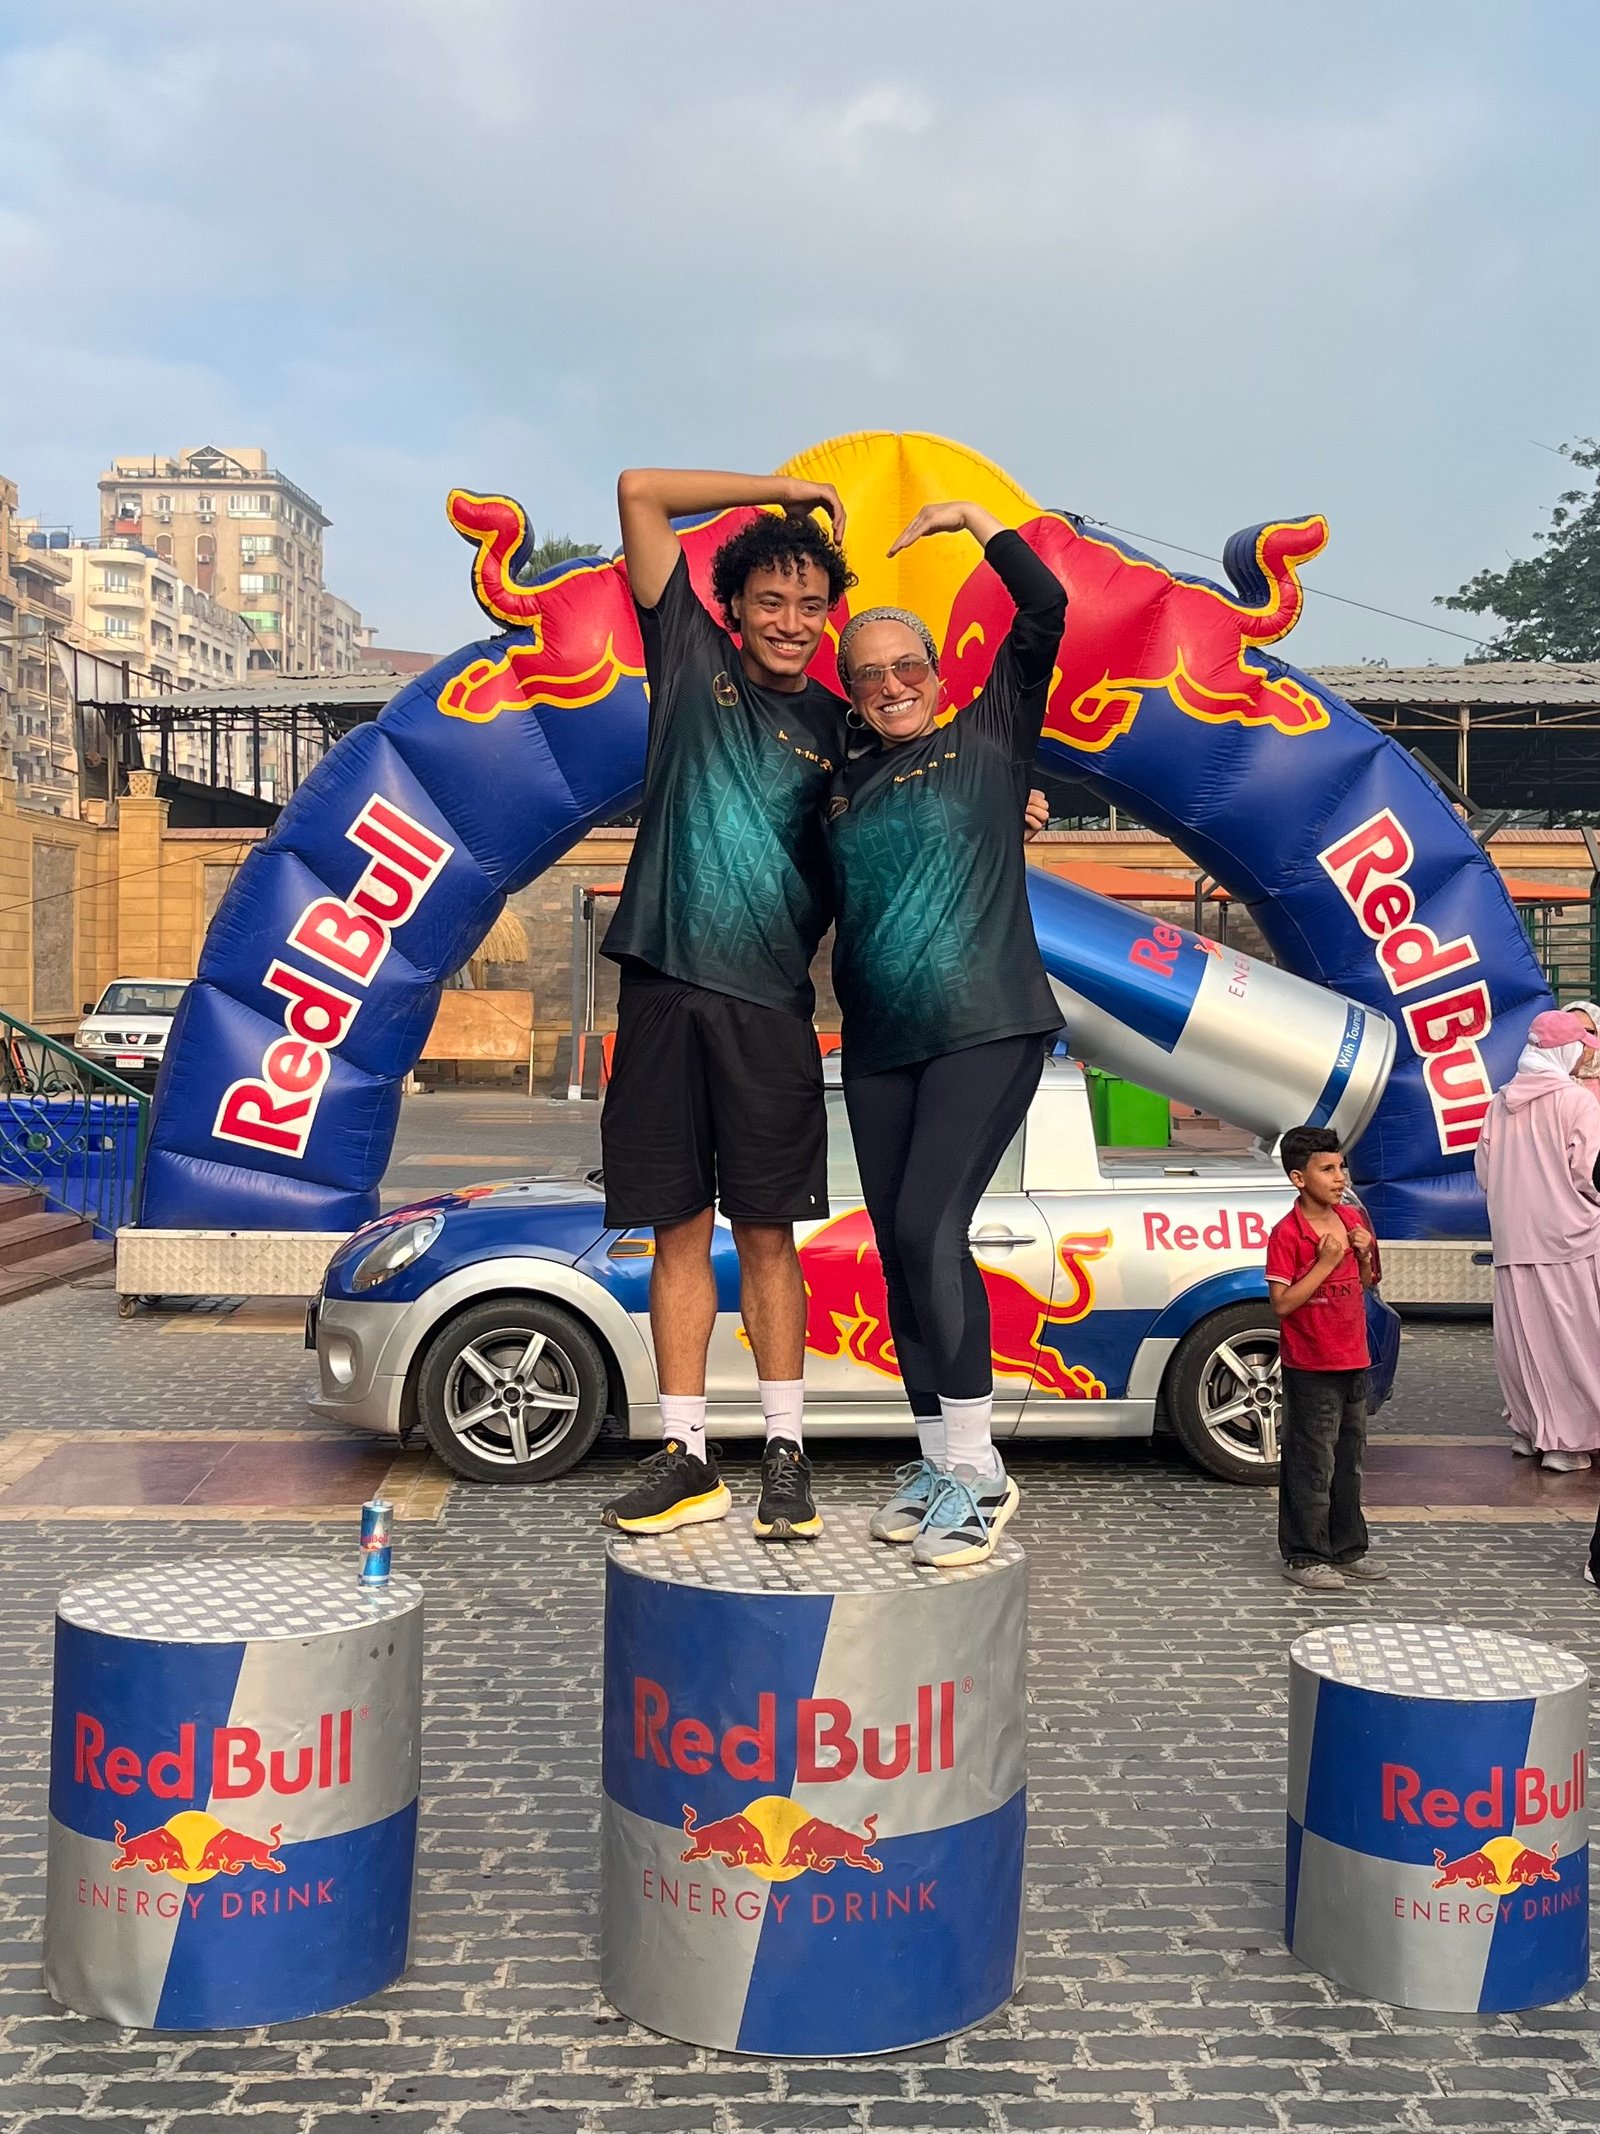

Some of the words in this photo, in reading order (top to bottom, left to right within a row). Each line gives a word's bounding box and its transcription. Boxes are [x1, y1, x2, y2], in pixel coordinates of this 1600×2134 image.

[1322, 811, 1475, 990] Red
[217, 963, 356, 1155] Red
[291, 798, 449, 982] Bull
[1128, 916, 1183, 978] Re
[1336, 1042, 1356, 1068] With
[1142, 1209, 1232, 1251] Red
[74, 1711, 197, 1801] Red
[212, 1708, 353, 1800] Bull
[633, 1675, 777, 1783] Red
[796, 1680, 955, 1784] Bull
[1381, 1762, 1504, 1829] Red
[1514, 1748, 1585, 1827] Bull
[78, 1878, 205, 1919] ENERGY
[221, 1877, 335, 1920] DRINK
[642, 1869, 791, 1924] ENERGY
[811, 1880, 938, 1925] DRINK
[1394, 1896, 1513, 1924] ENERGY
[1523, 1884, 1582, 1921] DRINK
